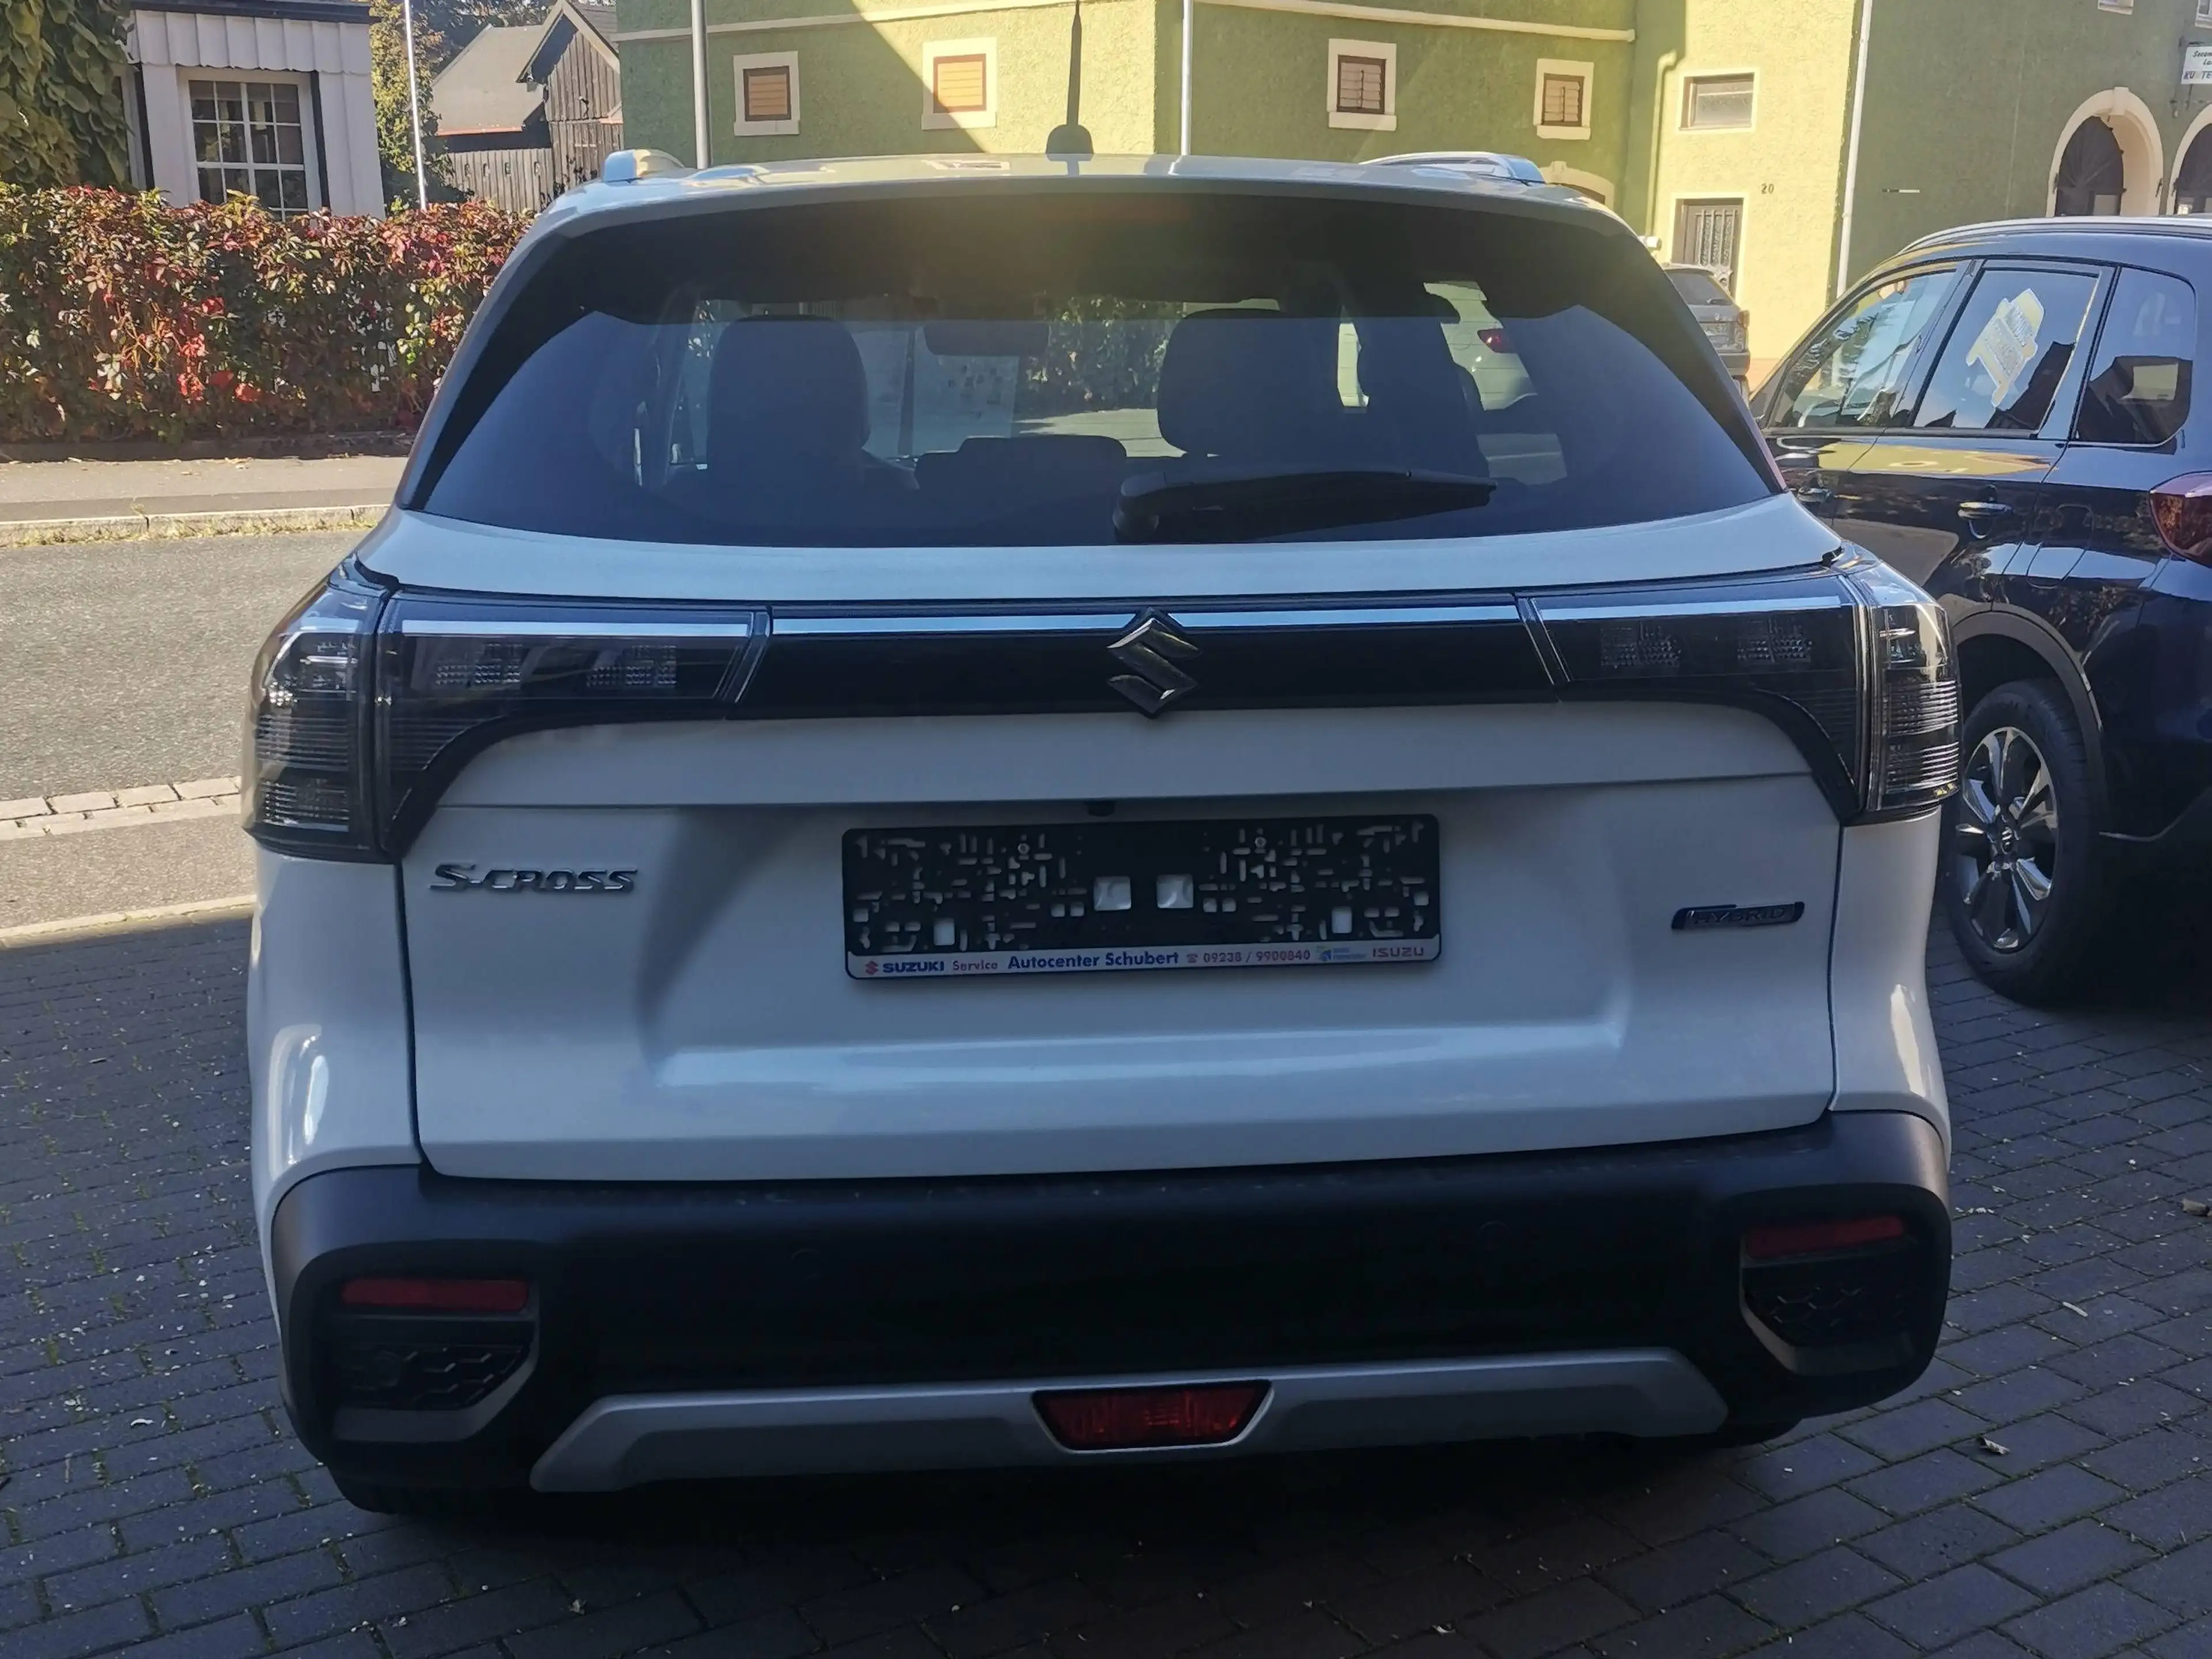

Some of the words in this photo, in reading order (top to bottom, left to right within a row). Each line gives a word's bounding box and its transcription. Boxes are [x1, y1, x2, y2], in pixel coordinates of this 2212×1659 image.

[1761, 183, 1774, 195] 20
[1695, 908, 1784, 924] HYBRID
[883, 961, 944, 972] SUZUKI
[952, 958, 998, 970] Service
[1008, 955, 1100, 969] Autocenter
[1105, 950, 1179, 966] Schubert
[1203, 952, 1242, 963] 09238
[1256, 949, 1311, 961] 9900840
[1372, 947, 1425, 957] ISUZU
